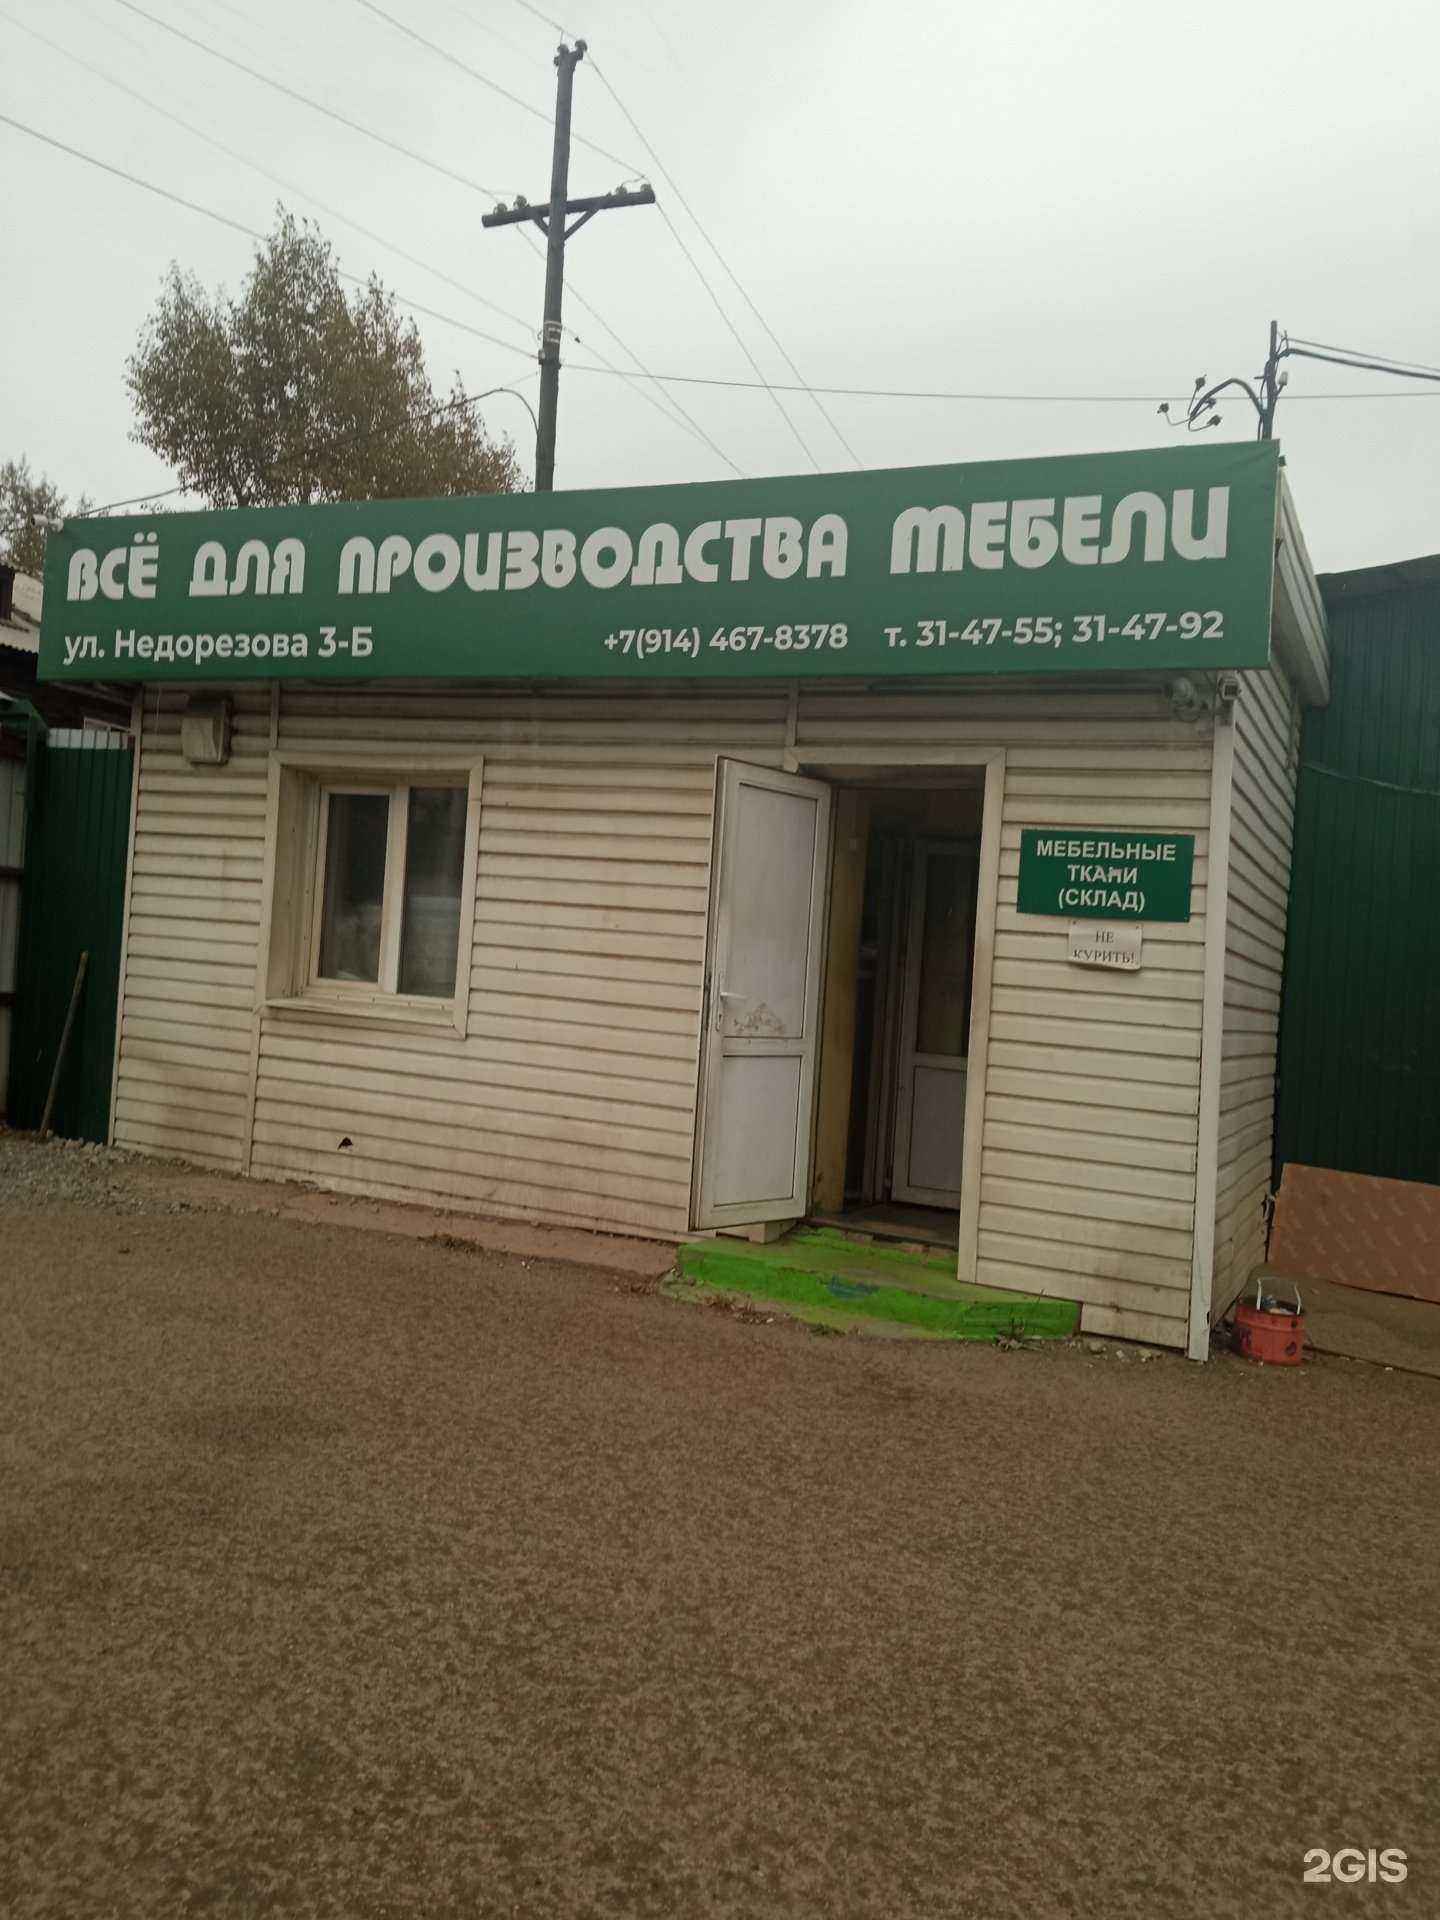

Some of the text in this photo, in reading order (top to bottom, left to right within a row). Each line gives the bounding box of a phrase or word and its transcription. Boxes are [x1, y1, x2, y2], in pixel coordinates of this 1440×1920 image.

[67, 486, 1231, 601] ВСЁ ДЛЯ ПРОИЗВОДСТВА МЕБЕЛИ
[604, 623, 849, 659] +7(914) 467-8378
[884, 610, 1225, 649] т. 31-47-55; 31-47-92
[63, 626, 373, 665] ул. Недорезова 3-Б
[1036, 839, 1177, 862] МЕБЕЛЬНЫЕ
[1067, 864, 1139, 884] ТКАНИ
[1058, 888, 1146, 913] (СКЛАД)
[1095, 930, 1115, 944] НЕ
[1073, 949, 1135, 965] КУРИТЬ!
